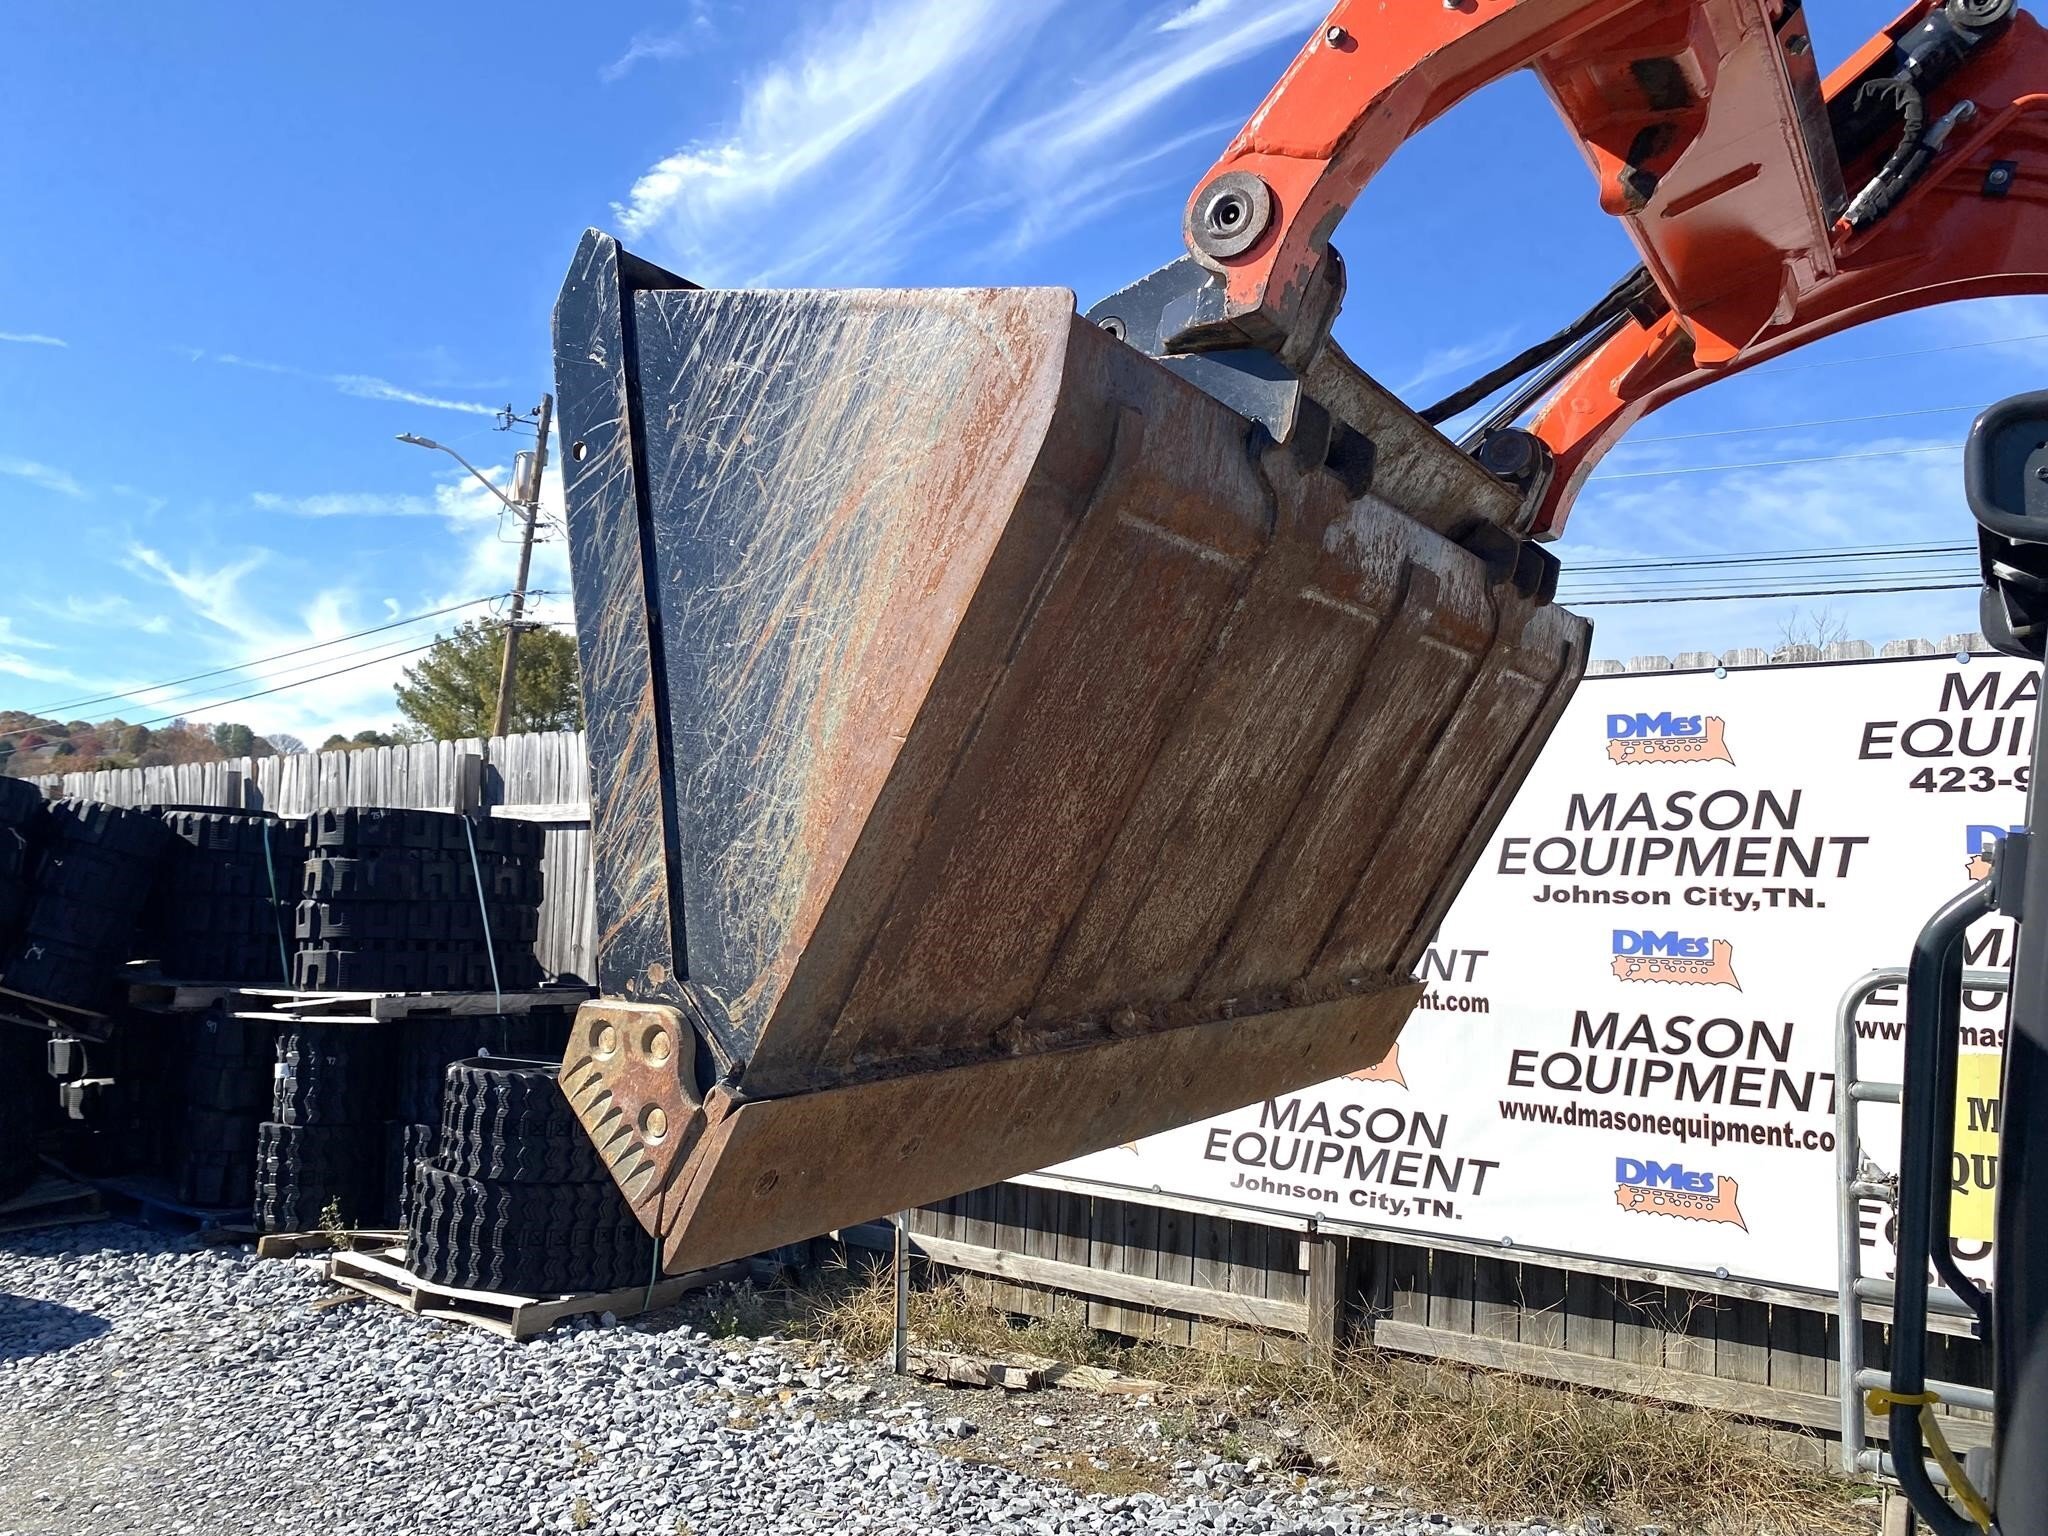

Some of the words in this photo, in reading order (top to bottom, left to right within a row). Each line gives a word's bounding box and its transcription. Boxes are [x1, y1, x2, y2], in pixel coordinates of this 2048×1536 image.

[1565, 788, 1802, 832] MASON
[1497, 836, 1870, 878] EQUIPMENT
[1532, 884, 1671, 905] Johnson
[1570, 1010, 1794, 1063] MASON
[1259, 1098, 1449, 1150] MASON
[1499, 1100, 1836, 1152] www.dmasonequipment.co
[1203, 1127, 1500, 1196] EQUIPMENT
[1229, 1172, 1340, 1204] Johnson
